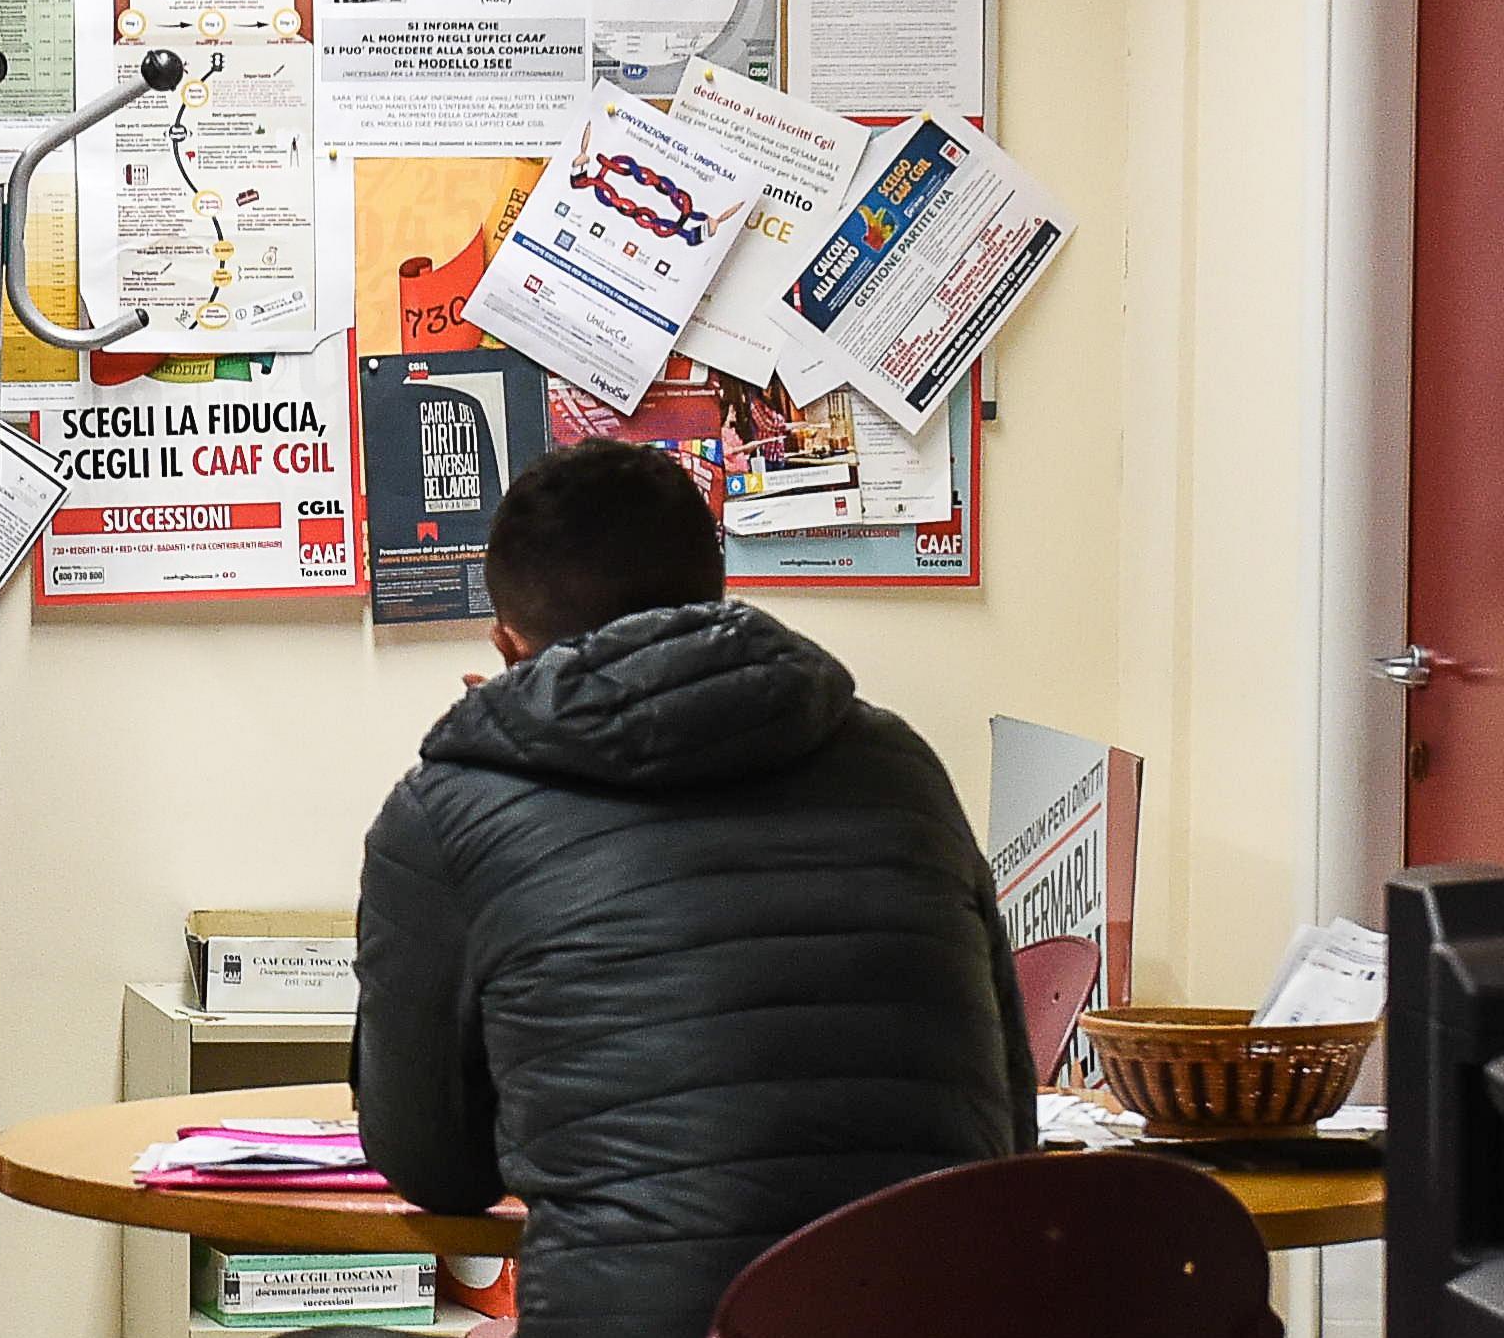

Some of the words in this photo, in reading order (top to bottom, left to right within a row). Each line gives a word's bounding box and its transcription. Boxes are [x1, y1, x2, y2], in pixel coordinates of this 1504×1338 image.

[362, 34, 375, 43] AL
[378, 34, 434, 43] MOMENTO
[438, 34, 470, 43] NEGLI
[475, 34, 512, 43] UFFICI
[515, 34, 547, 43] CAAF
[407, 22, 419, 31] SI
[423, 22, 474, 31] INFORMA
[479, 22, 499, 31] CHE
[323, 46, 335, 55] SI
[369, 46, 433, 55] PROCEDERE
[437, 46, 463, 55] ALLA
[467, 46, 494, 55] SOLA
[499, 46, 584, 55] COMPILAZIONE
[394, 60, 415, 68] DEL
[419, 59, 479, 69] MODELLO
[484, 59, 512, 69] ISEE
[693, 84, 742, 112] dedicato
[743, 105, 756, 118] ai
[756, 110, 777, 127] soli
[777, 119, 813, 142] iscritti
[812, 133, 837, 153] Cgil
[616, 107, 672, 146] CONVENZIONE
[670, 139, 691, 156] CGIL
[877, 159, 912, 196] SCELGO
[888, 178, 915, 206] CAAF
[907, 157, 932, 182] CGIL
[494, 187, 527, 246] ISEE
[811, 236, 849, 276] CALCOLI
[853, 253, 902, 306] GESTIONE
[897, 209, 938, 253] PARTITE
[932, 187, 955, 211] IVA
[811, 275, 836, 301] ALLA
[828, 245, 860, 280] MANO
[408, 361, 429, 371] CGIL
[62, 406, 154, 440] SCEGLI
[165, 405, 198, 436] LA
[208, 401, 326, 437] FIDUCIA,
[420, 401, 455, 424] CARTA
[458, 402, 475, 423] DEI
[421, 422, 478, 455] DIRITTI
[58, 448, 150, 480] SCEGLI
[160, 446, 183, 478] IL
[191, 444, 263, 477] CAAF
[273, 442, 334, 474] CGIL
[422, 453, 479, 477] UNIVERSALI
[424, 477, 442, 500] DEL
[443, 475, 480, 499] LAVORO
[102, 505, 231, 532] SUCCESSIONI
[297, 500, 345, 516] CGIL
[298, 543, 347, 564] CAAF
[916, 535, 963, 555] CAAF
[300, 567, 347, 577] Toscana
[916, 557, 963, 568] Toscana
[1047, 799, 1066, 834] PER
[1072, 759, 1104, 808] DIRITTI
[1023, 829, 1102, 948] FERMARLI,
[253, 957, 278, 966] CAAF
[281, 957, 306, 966] CGIL
[310, 957, 353, 967] TOSCAN
[263, 1272, 299, 1284] CAAF
[300, 1271, 332, 1283] CGIL
[336, 1269, 393, 1282] TOSCANA
[254, 1286, 330, 1297] documentazione
[332, 1285, 381, 1295] necessaria
[381, 1283, 399, 1295] per
[302, 1298, 354, 1308] successioni
